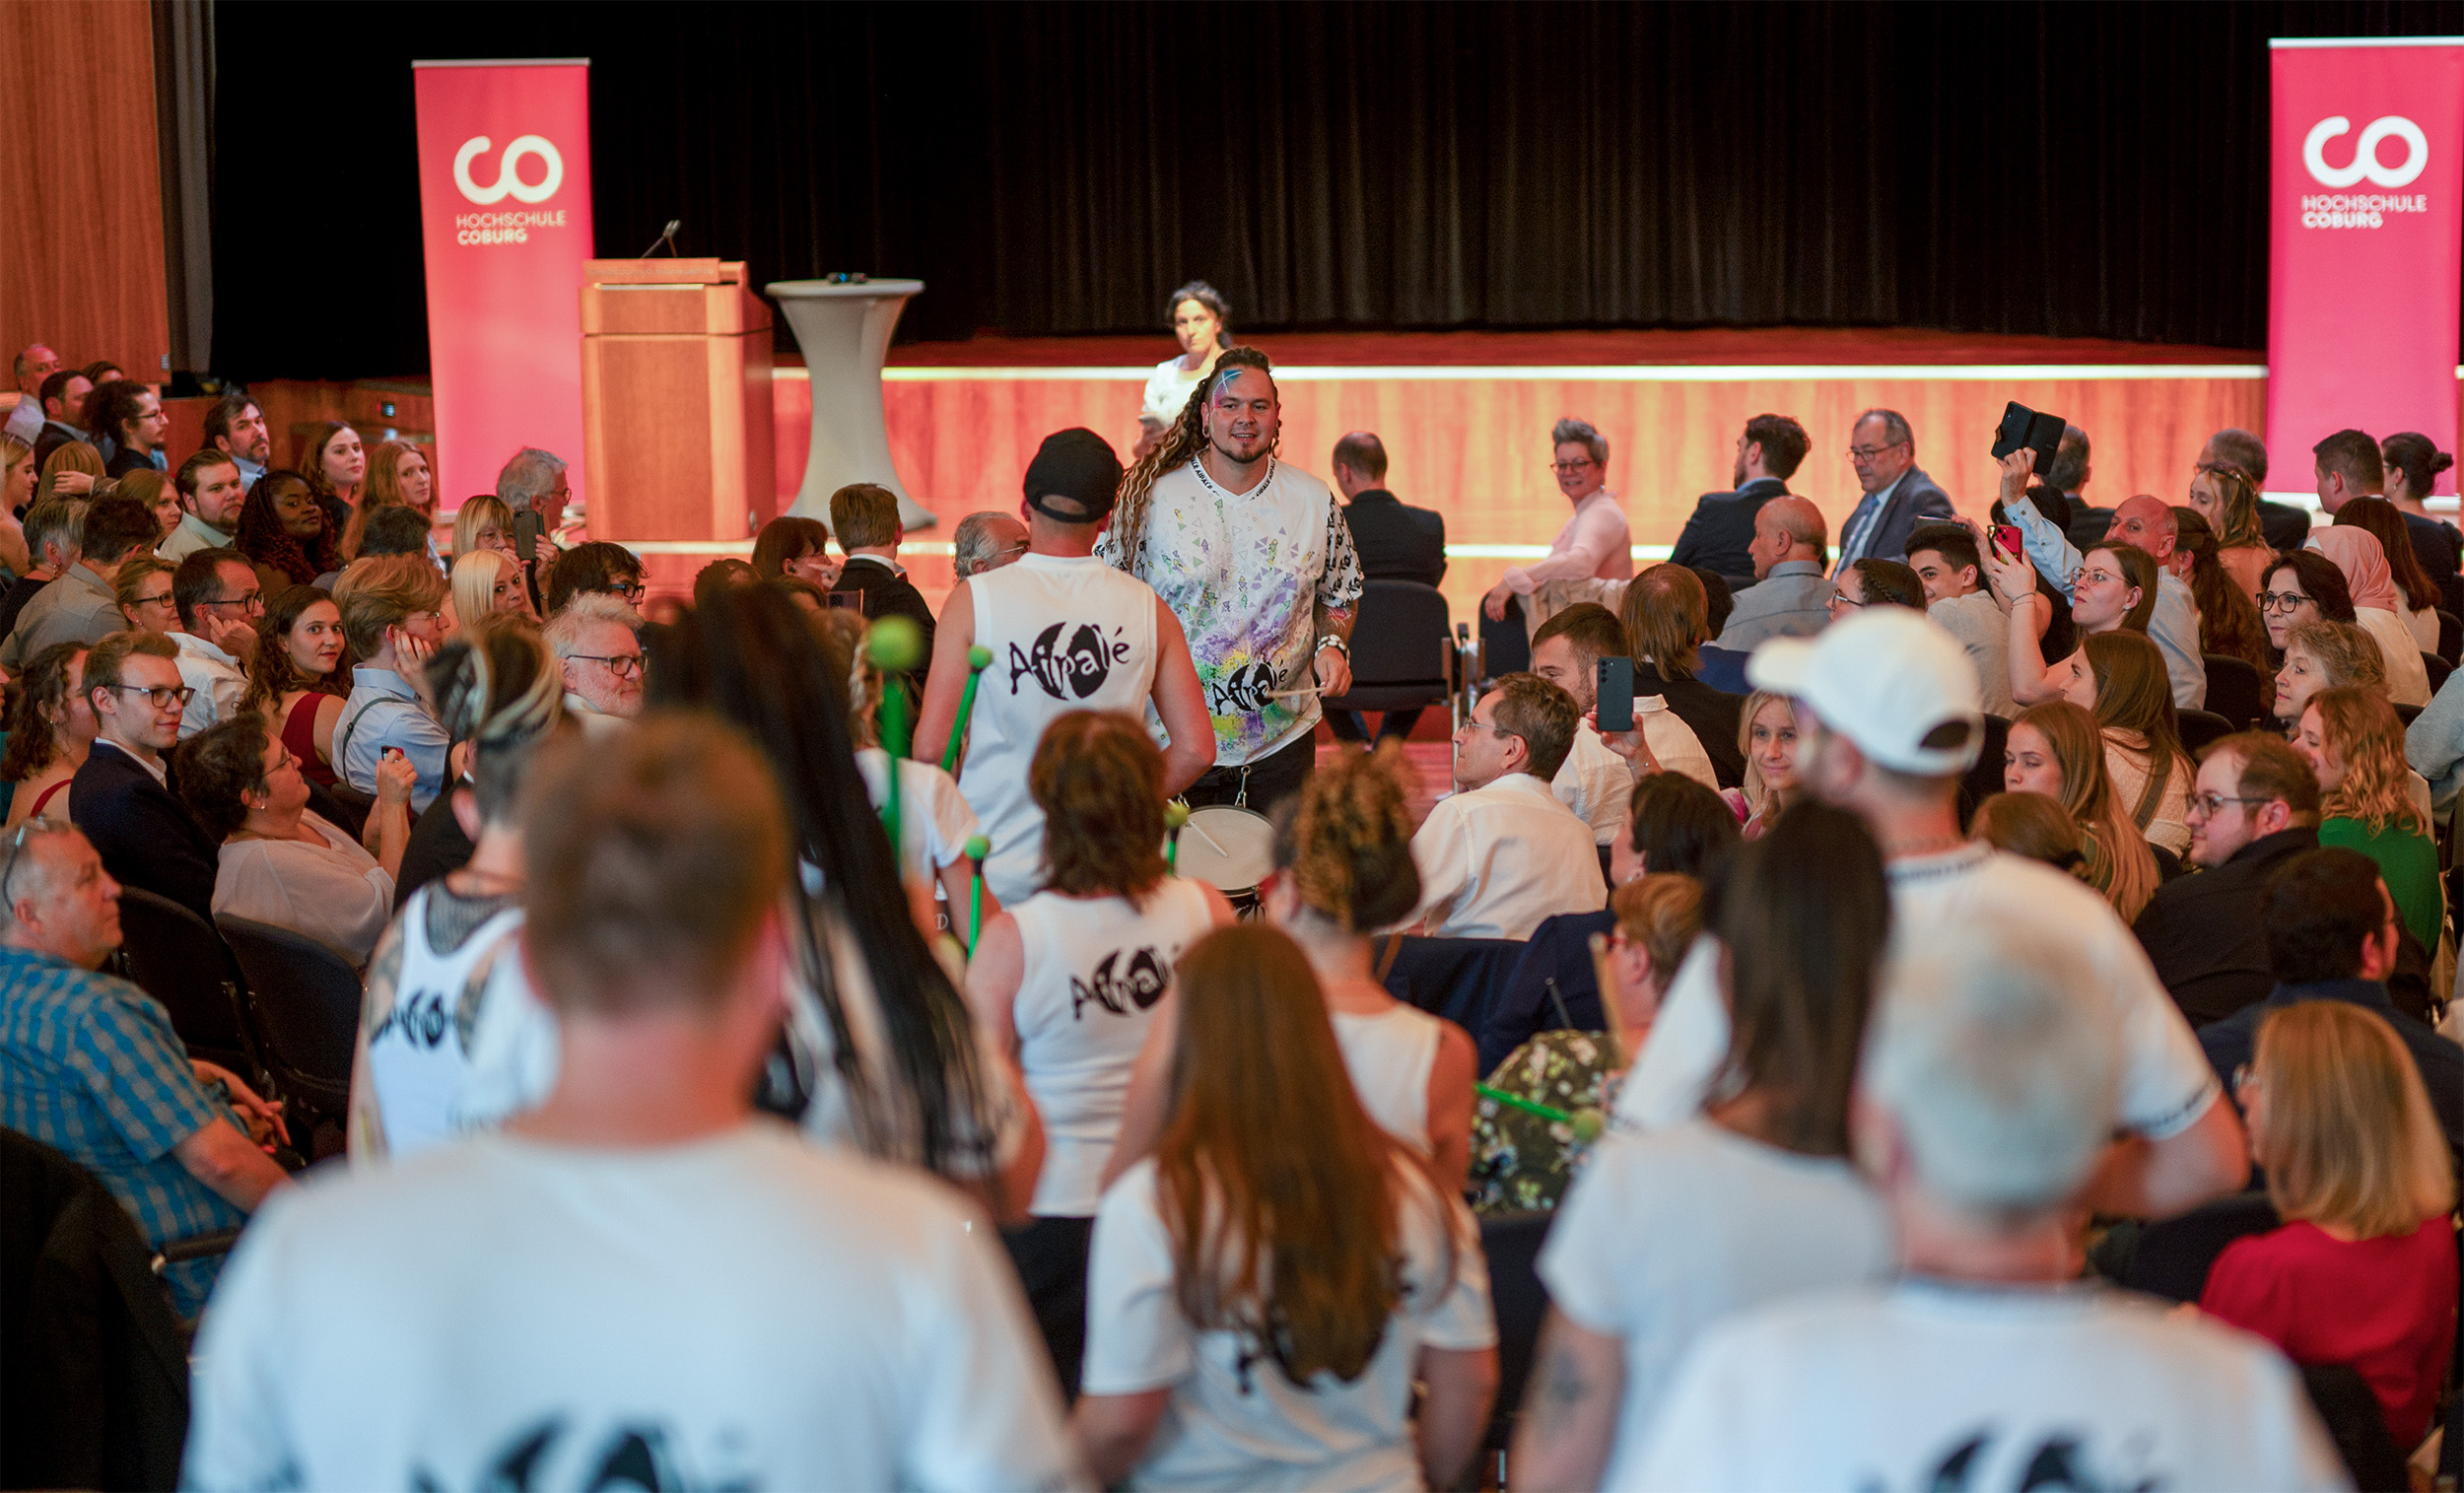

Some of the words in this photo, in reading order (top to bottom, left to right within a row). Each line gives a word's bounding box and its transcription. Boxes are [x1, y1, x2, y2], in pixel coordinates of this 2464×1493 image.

[2301, 194, 2428, 213] HOCHSCHULE
[456, 210, 567, 229] HOCHSCHULE
[2302, 210, 2383, 229] COBURG
[457, 228, 527, 245] COBURG
